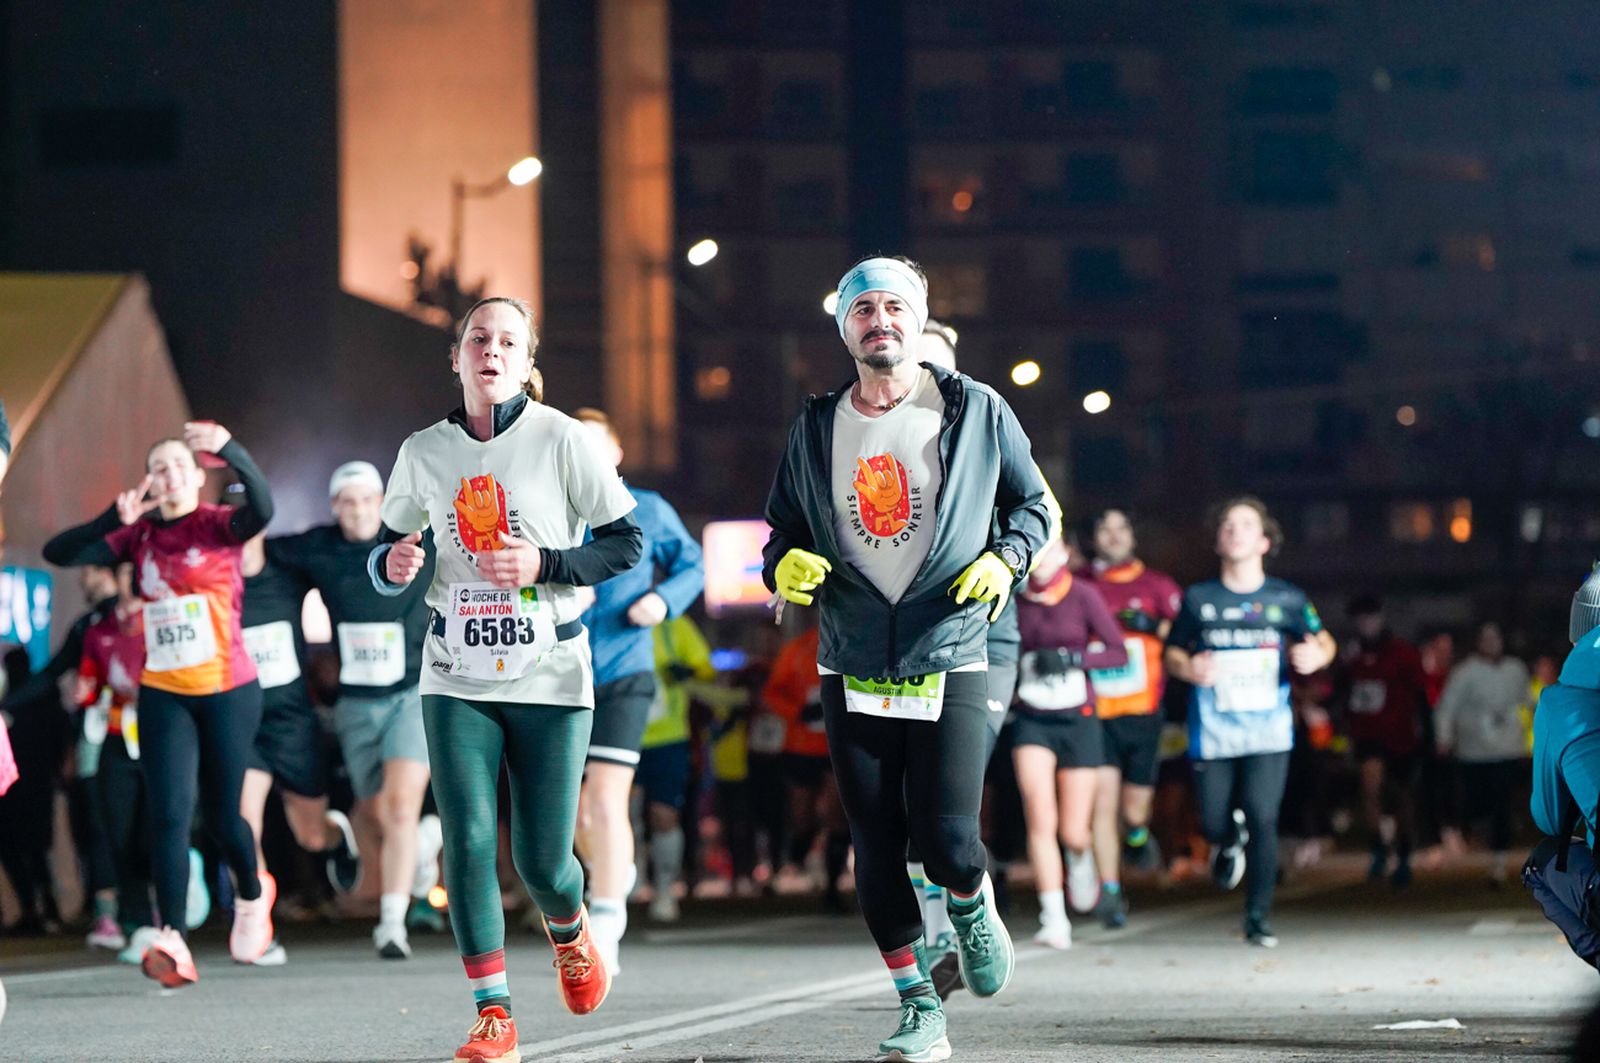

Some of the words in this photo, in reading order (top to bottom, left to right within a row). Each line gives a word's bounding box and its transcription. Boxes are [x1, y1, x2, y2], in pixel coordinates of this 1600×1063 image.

[847, 495, 881, 549] SIEMPRE
[892, 486, 922, 548] SONREÍR
[500, 592, 512, 602] DE
[464, 616, 535, 647] 6583
